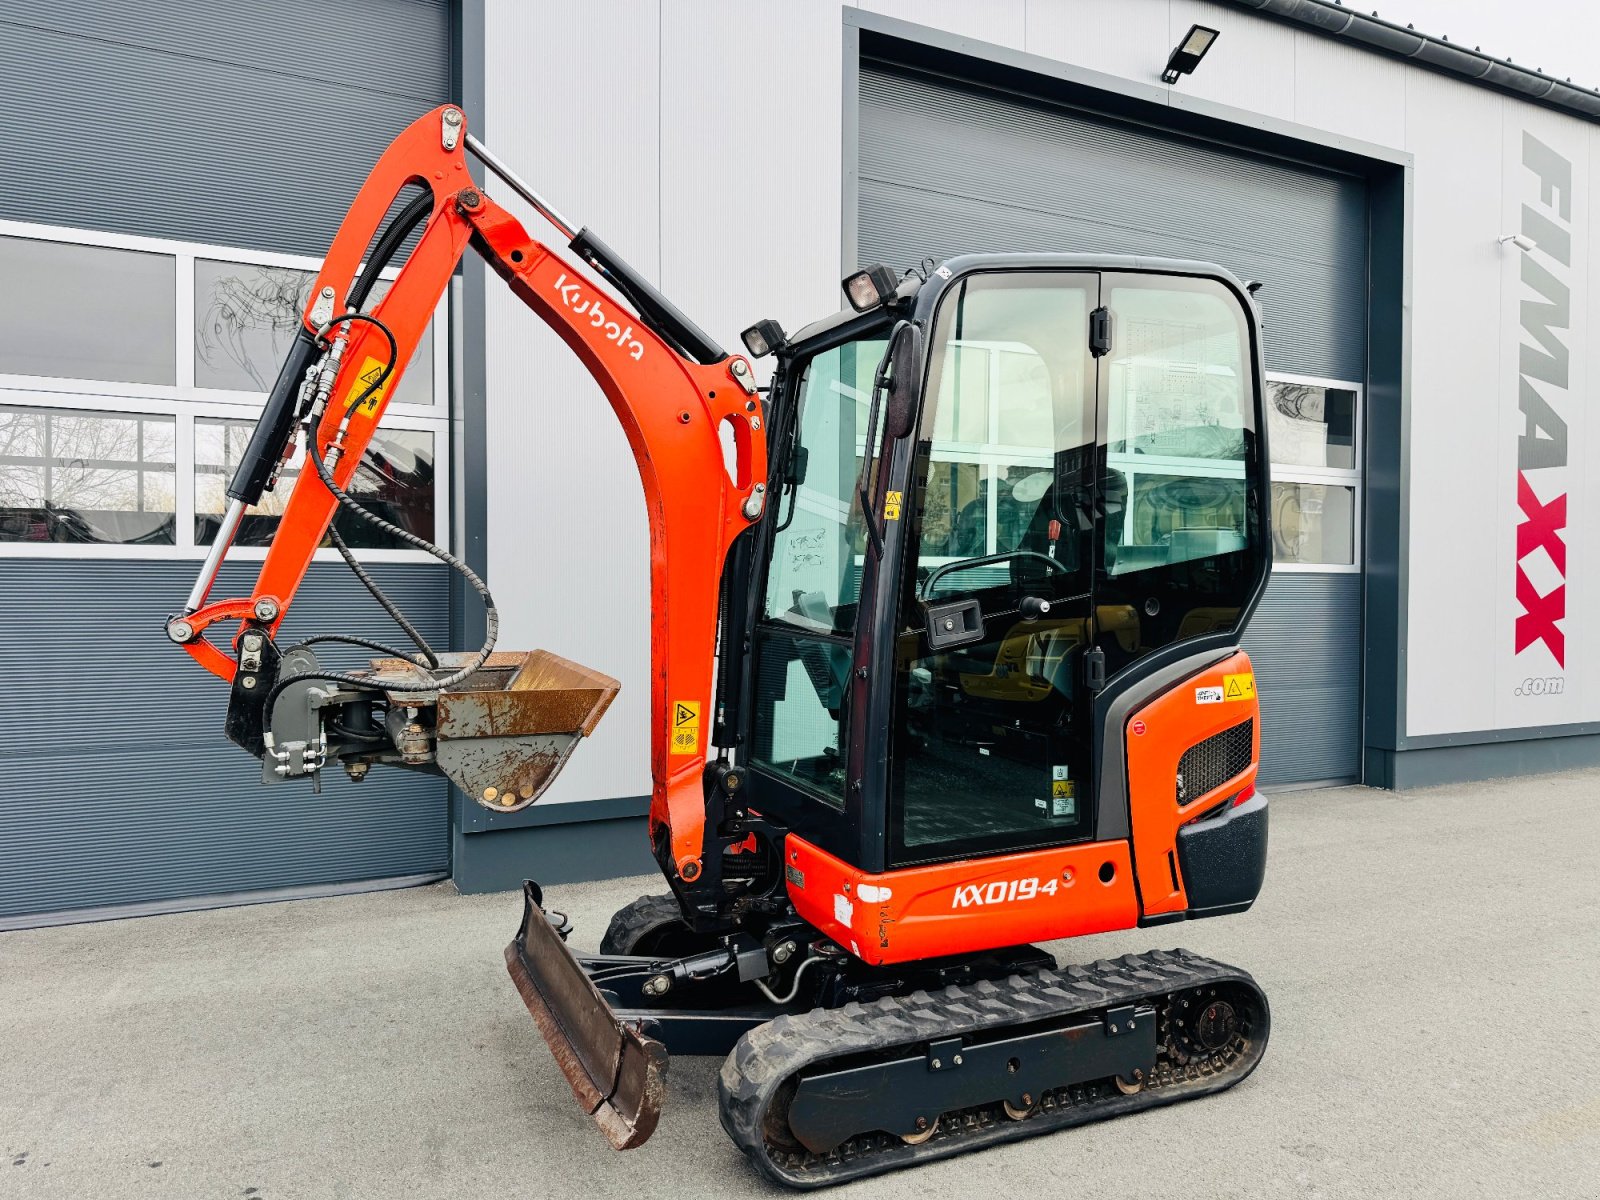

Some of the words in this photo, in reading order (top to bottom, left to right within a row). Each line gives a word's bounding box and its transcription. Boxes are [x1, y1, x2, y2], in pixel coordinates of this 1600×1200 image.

[553, 273, 645, 361] Kubota
[1514, 129, 1572, 671] FIMAXX
[1514, 676, 1565, 697] .com
